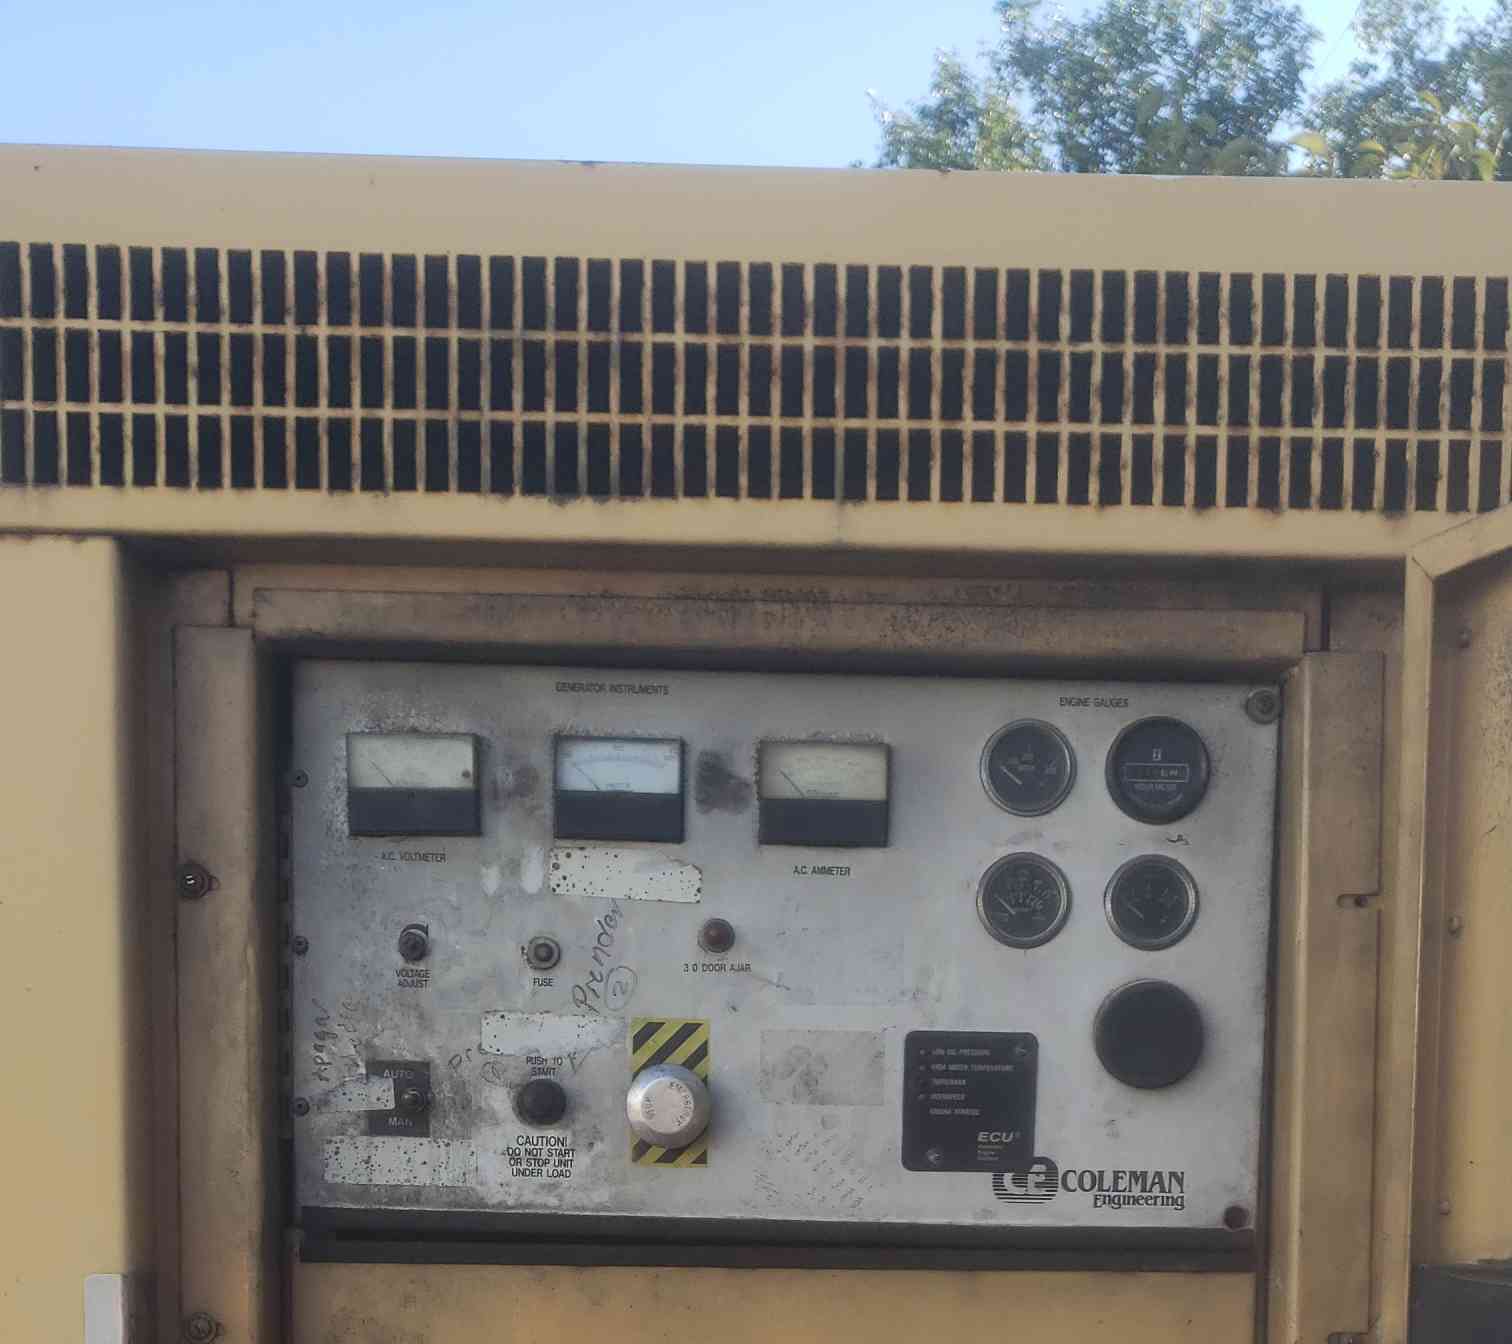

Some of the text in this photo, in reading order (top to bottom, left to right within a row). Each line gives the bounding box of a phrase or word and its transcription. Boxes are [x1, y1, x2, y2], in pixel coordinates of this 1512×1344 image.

[810, 865, 851, 877] AMMETER
[702, 963, 727, 973] DOOR
[396, 969, 431, 979] VOLTAGE
[397, 979, 429, 989] ADJUST
[533, 977, 554, 987] FUSE
[526, 1056, 548, 1066] PUSH
[383, 1069, 414, 1080] AUTO
[516, 1135, 568, 1147] CAUTION!
[977, 1131, 1014, 1142] ECU
[506, 1147, 576, 1158] DO NOT START
[508, 1157, 574, 1169] OR STOP UNIT
[511, 1168, 572, 1178] UNDER LOAD
[1060, 1169, 1185, 1194] COLEMAN
[1092, 1193, 1185, 1211] Engineering
